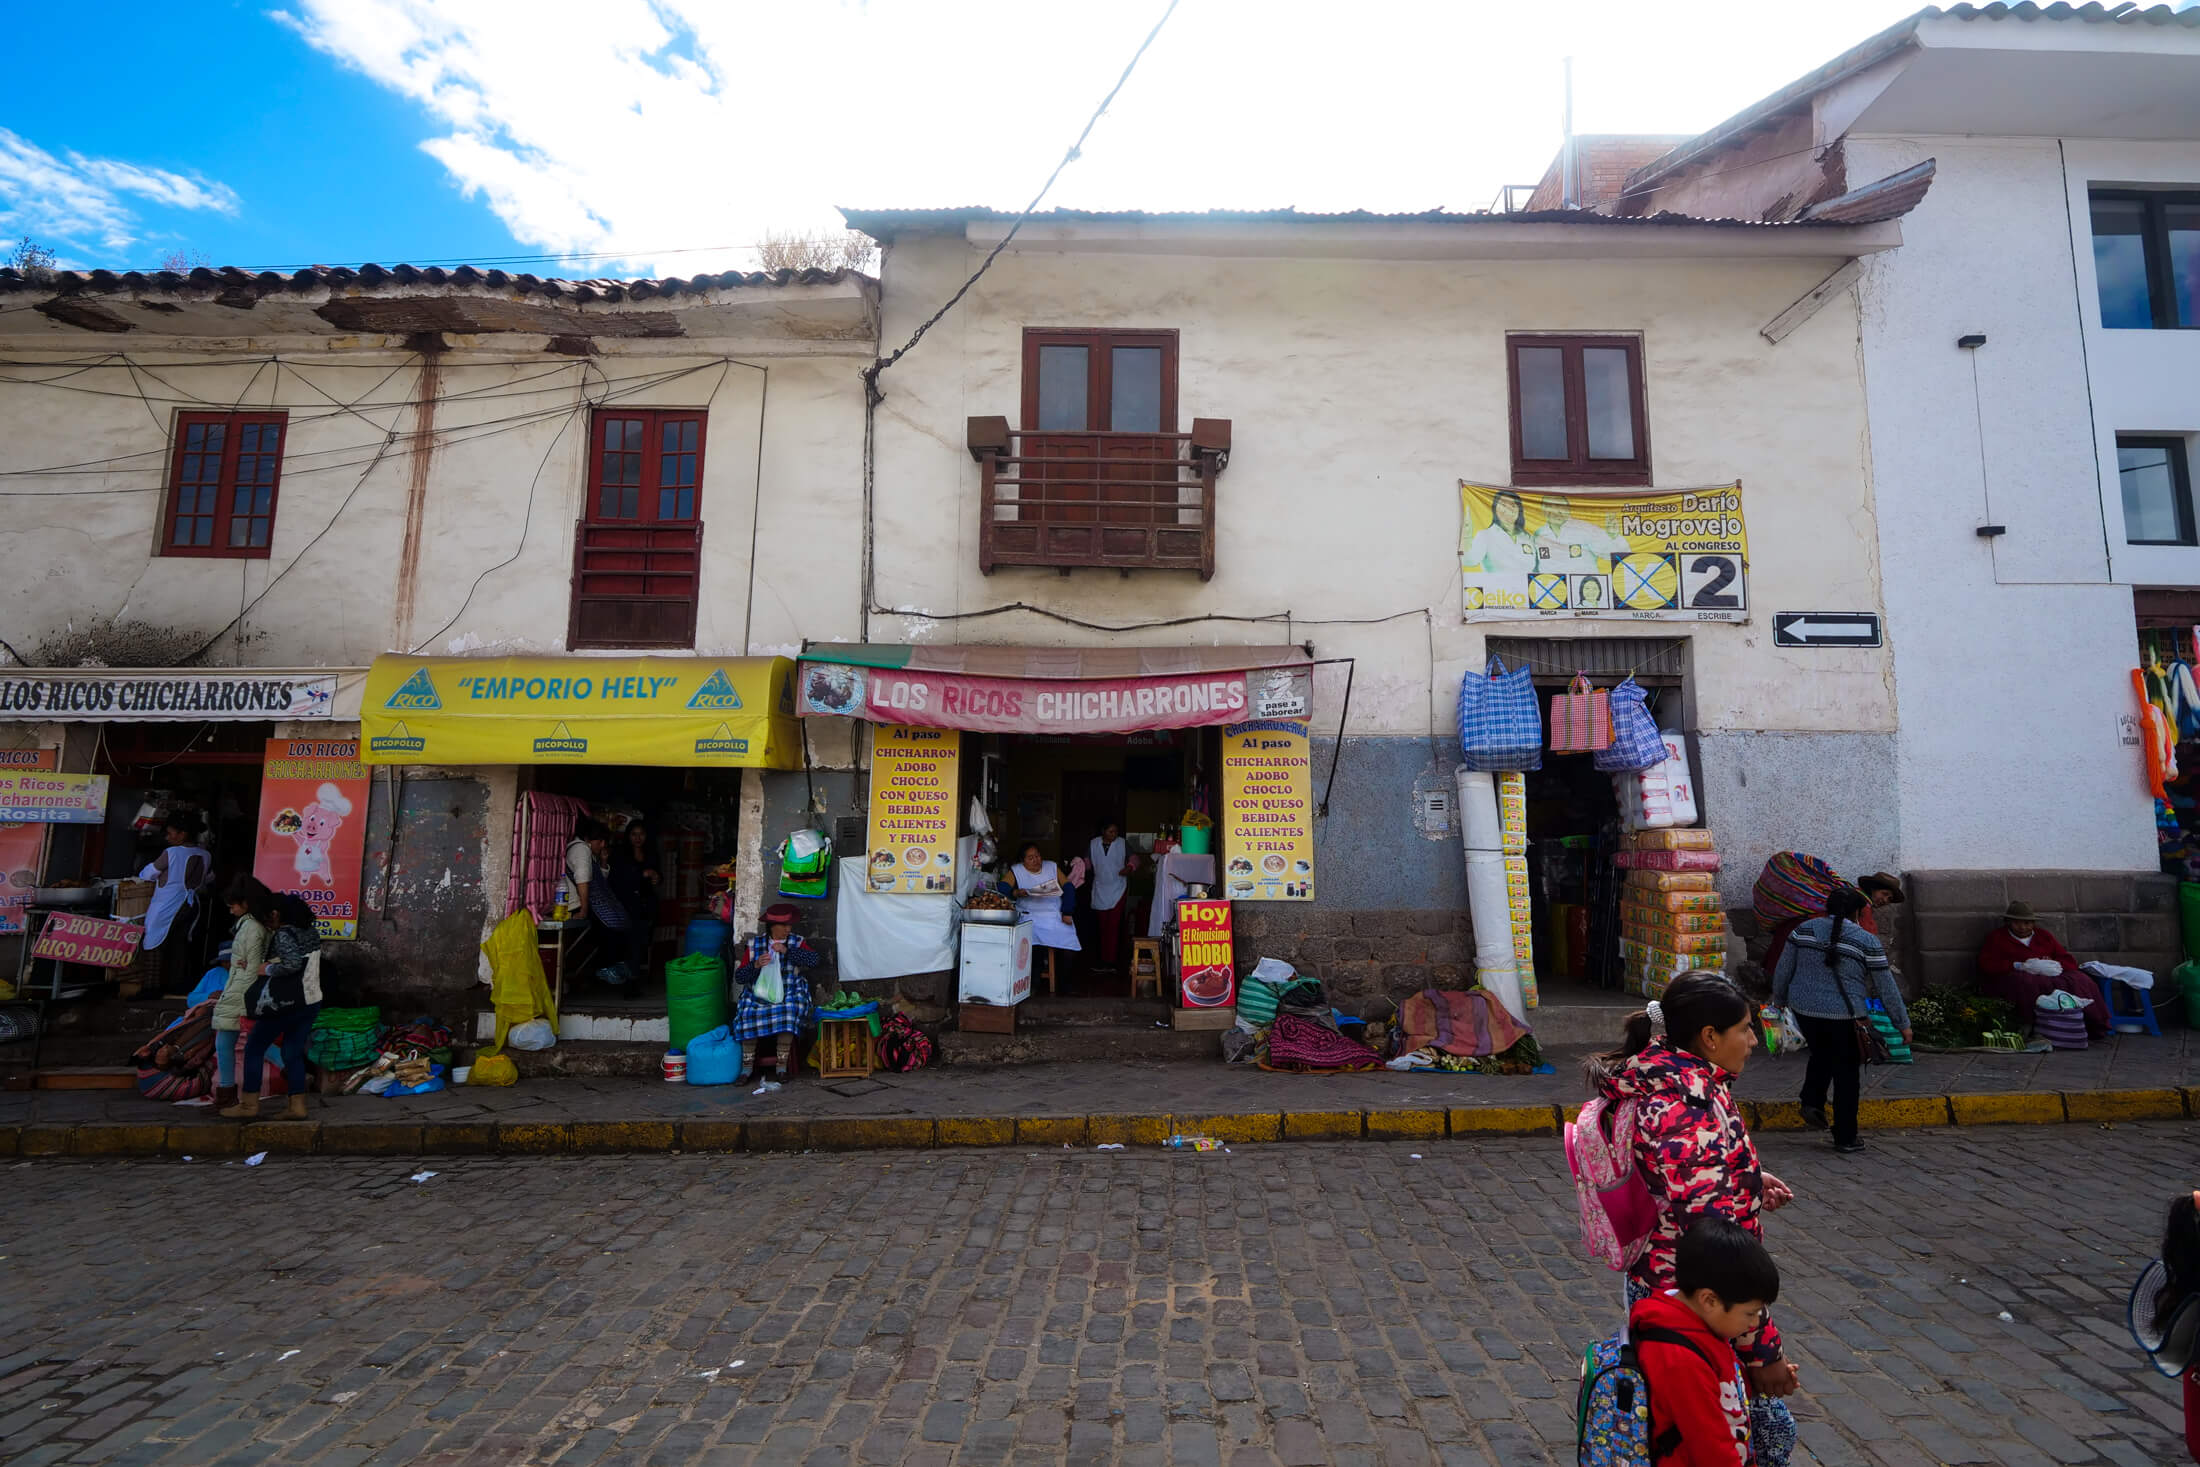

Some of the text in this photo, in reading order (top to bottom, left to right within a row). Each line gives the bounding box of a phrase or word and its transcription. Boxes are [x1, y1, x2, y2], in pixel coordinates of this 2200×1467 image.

[1622, 503, 1678, 514] Arquitecto
[1622, 514, 1742, 539] Mogrovejo
[1665, 542, 1741, 550] AL CONGRESO
[1690, 556, 1739, 607] 2
[1697, 612, 1732, 620] ESCRIBE
[0, 681, 295, 712] LOS RICOS CHICHARRONES
[394, 693, 435, 708] RICO
[695, 694, 736, 708] RICO
[872, 679, 1244, 721] LOS RICOS CHICHARRONES
[1260, 706, 1305, 717] saborear
[1265, 701, 1289, 711] pase
[893, 729, 942, 741] Al paso
[373, 739, 422, 749] RICOPOLLO
[536, 740, 584, 750] RICOPOLLO
[698, 741, 746, 751] RICOPOLLO
[1242, 738, 1292, 750] Al paso
[288, 743, 356, 757] LOS RICOS
[876, 748, 957, 758] CHICHARRON
[894, 762, 937, 772] ADOBO
[1225, 757, 1308, 767] CHICHARRON
[266, 760, 367, 778] CHICHARRONES
[891, 776, 940, 786] CHOCLO
[1246, 771, 1289, 781] ADOBO
[20, 777, 65, 791] Ricos
[1243, 785, 1293, 794] CHOCLO
[879, 790, 949, 801] CON QUESO
[887, 805, 940, 815] BEBIDAS
[1232, 799, 1304, 810] CON QUESO
[0, 808, 71, 820] Rosita
[1241, 813, 1297, 823] BEBIDAS
[879, 819, 947, 829] CALIENTES
[1234, 827, 1304, 837] CALIENTES
[888, 833, 937, 844] Y FRIAS
[1245, 841, 1295, 851] Y FRIAS
[1180, 904, 1229, 925] Hoy
[67, 918, 123, 942] HOY EL
[1183, 928, 1190, 942] El
[37, 938, 133, 967] RICO ADOBO
[1183, 943, 1231, 966] ADOBO
